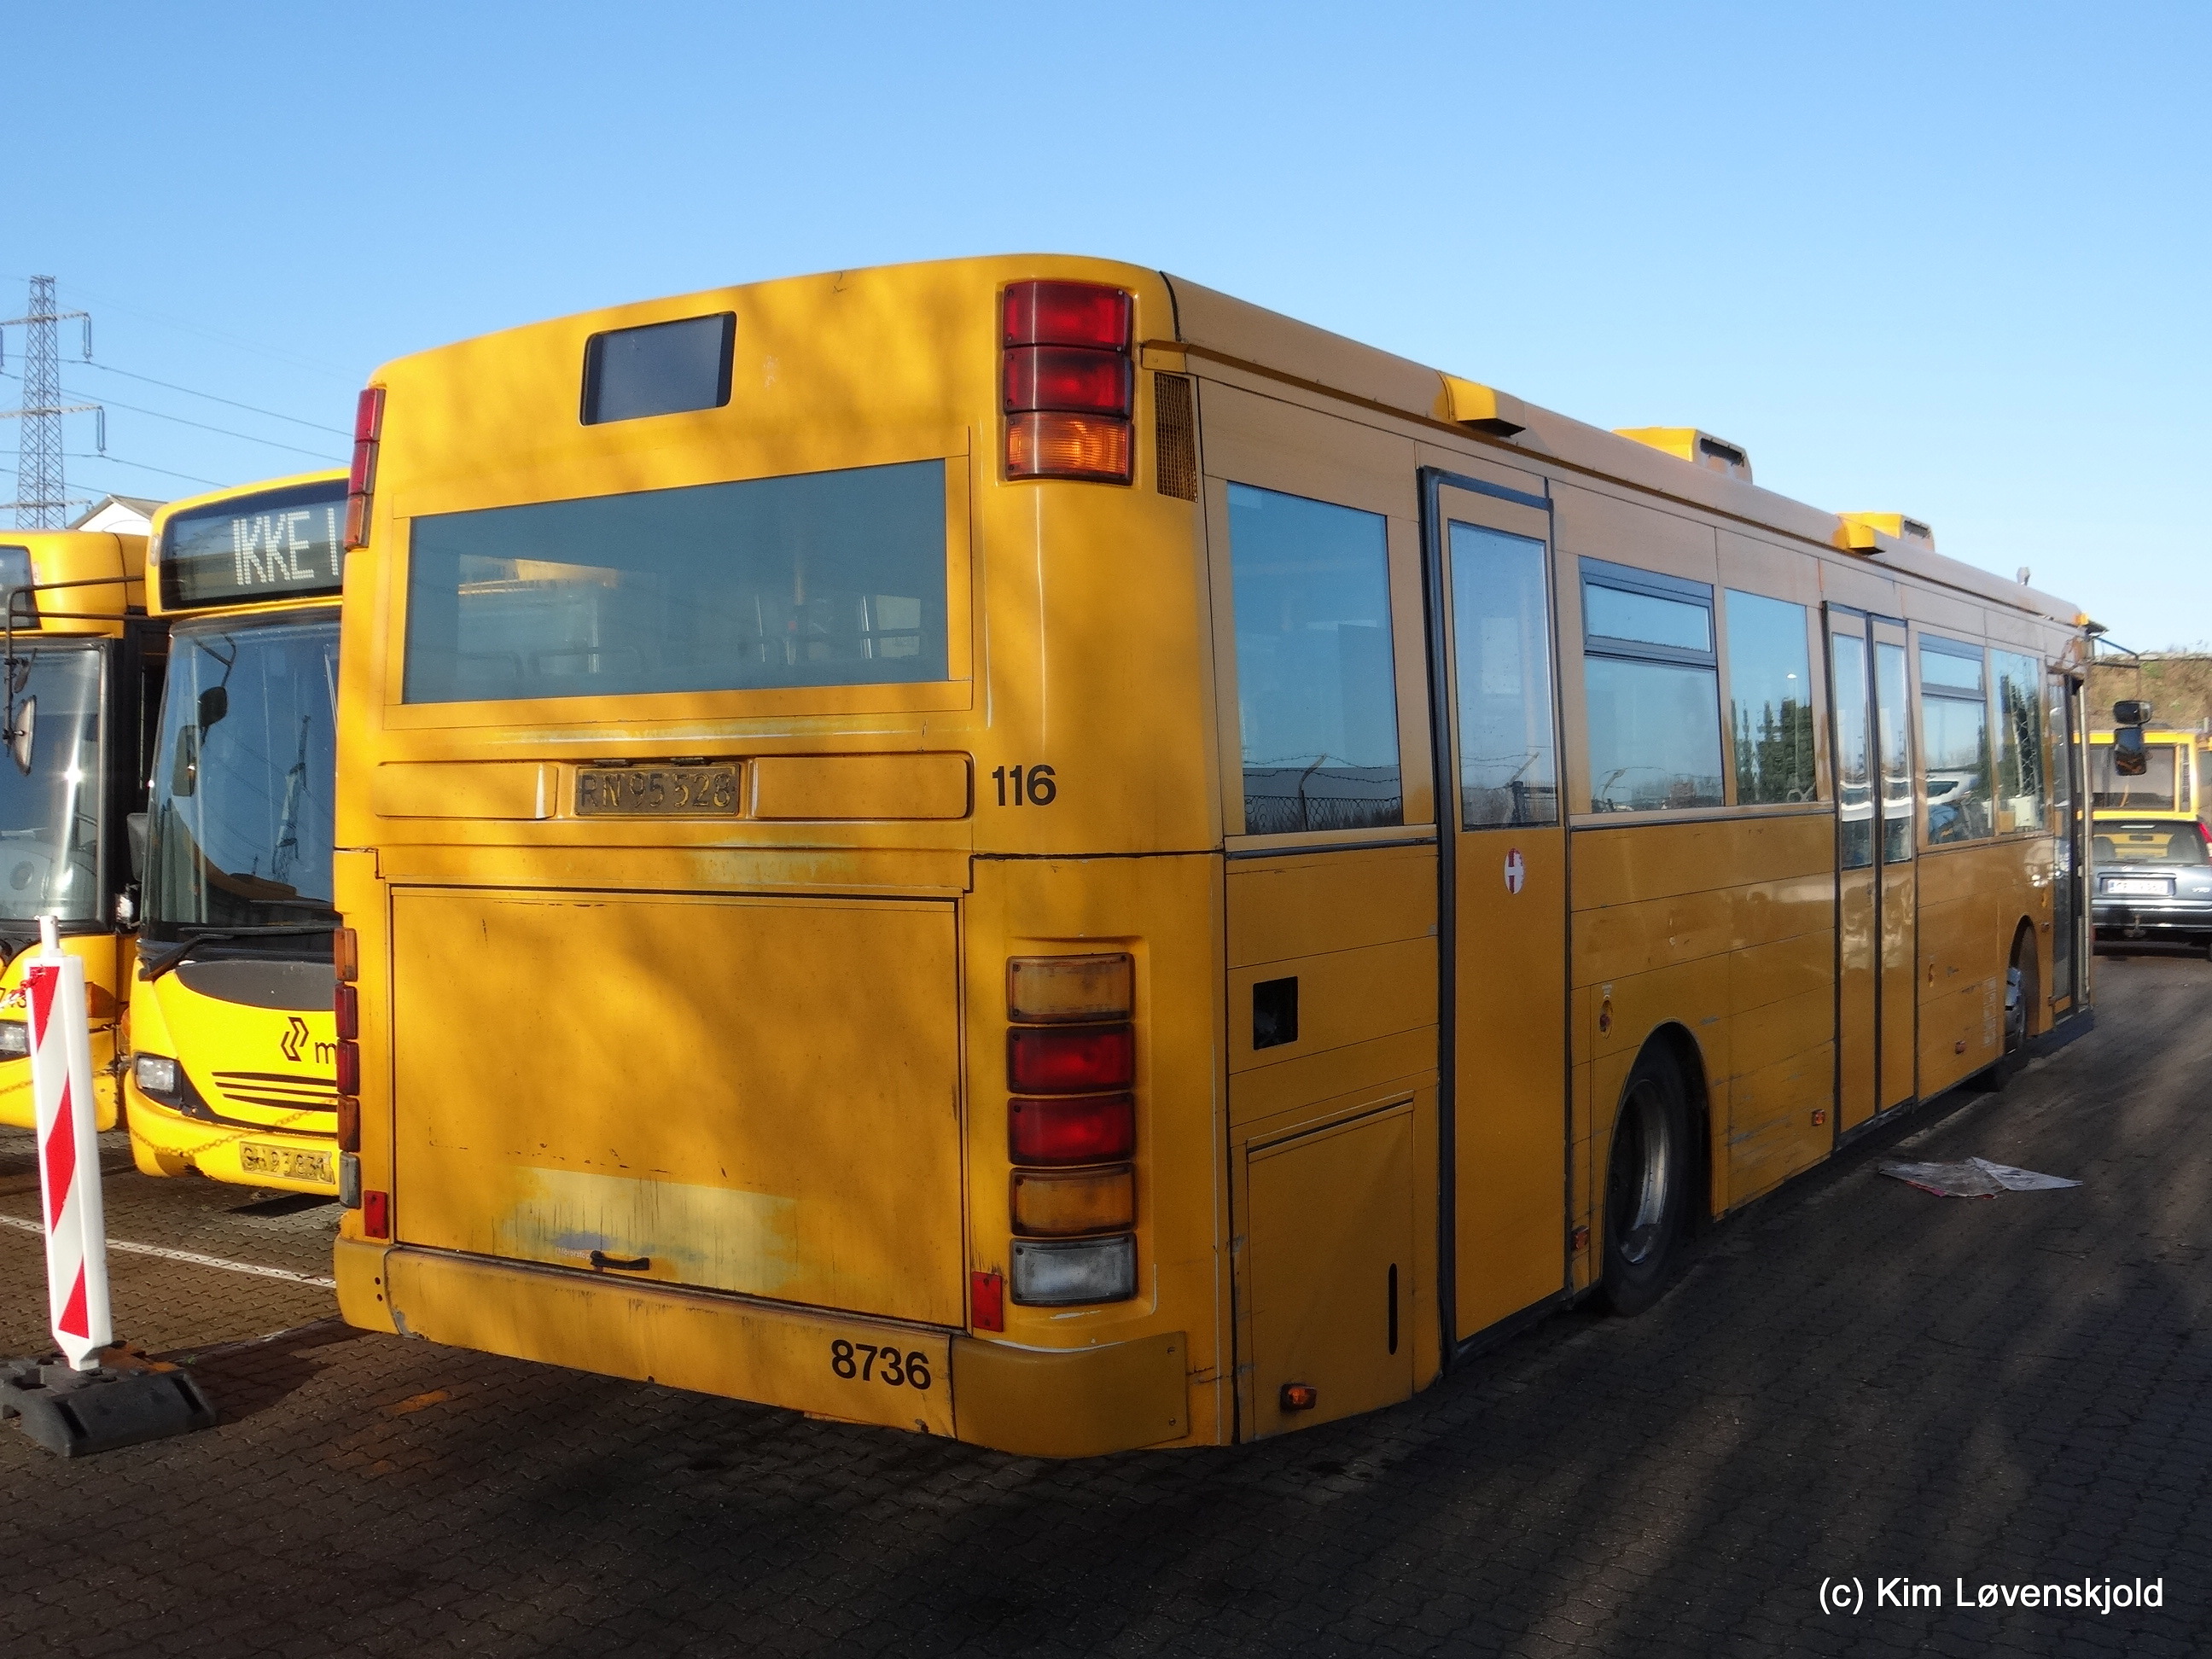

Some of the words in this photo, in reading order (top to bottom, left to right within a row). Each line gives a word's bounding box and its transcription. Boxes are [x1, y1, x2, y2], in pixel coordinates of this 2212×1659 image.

[233, 511, 315, 585] IKKE
[580, 774, 621, 807] RN
[629, 772, 665, 808] 95
[673, 773, 731, 808] 528
[992, 764, 1057, 806] 116
[831, 1339, 932, 1390] 8736
